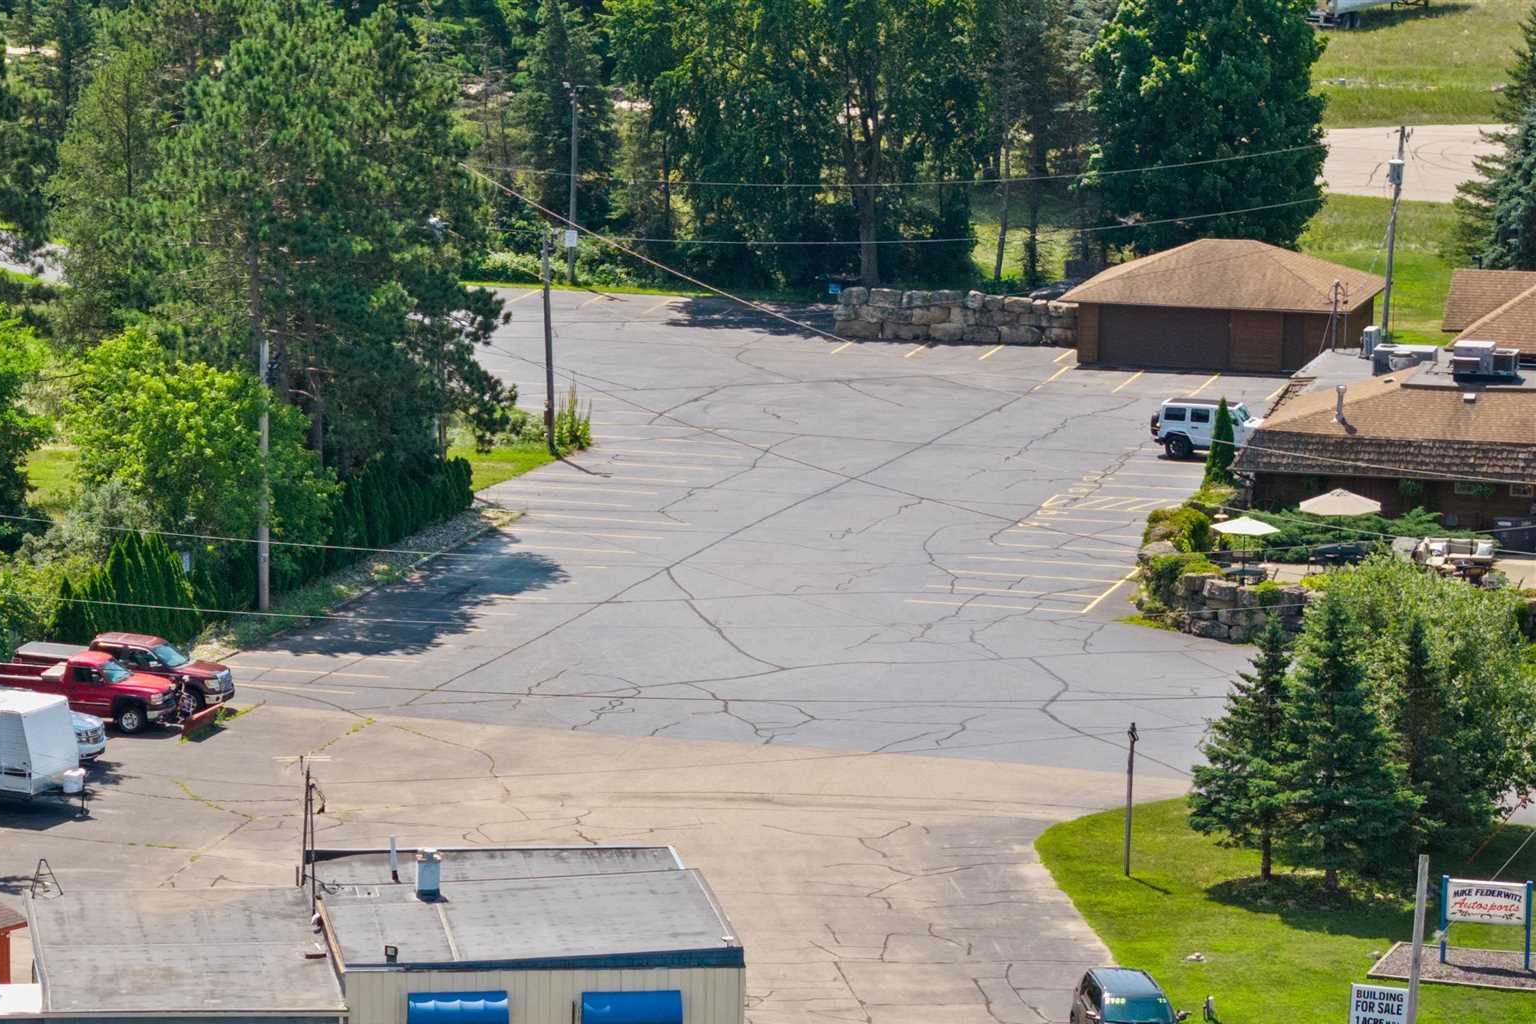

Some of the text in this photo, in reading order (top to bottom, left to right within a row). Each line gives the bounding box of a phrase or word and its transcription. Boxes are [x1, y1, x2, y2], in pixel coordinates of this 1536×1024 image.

[1453, 888, 1473, 898] MIKE
[1451, 897, 1520, 912] Autosports
[1356, 989, 1404, 1003] BUILDING
[1355, 1000, 1403, 1016] FOR SALE
[1355, 1016, 1360, 1024] 1
